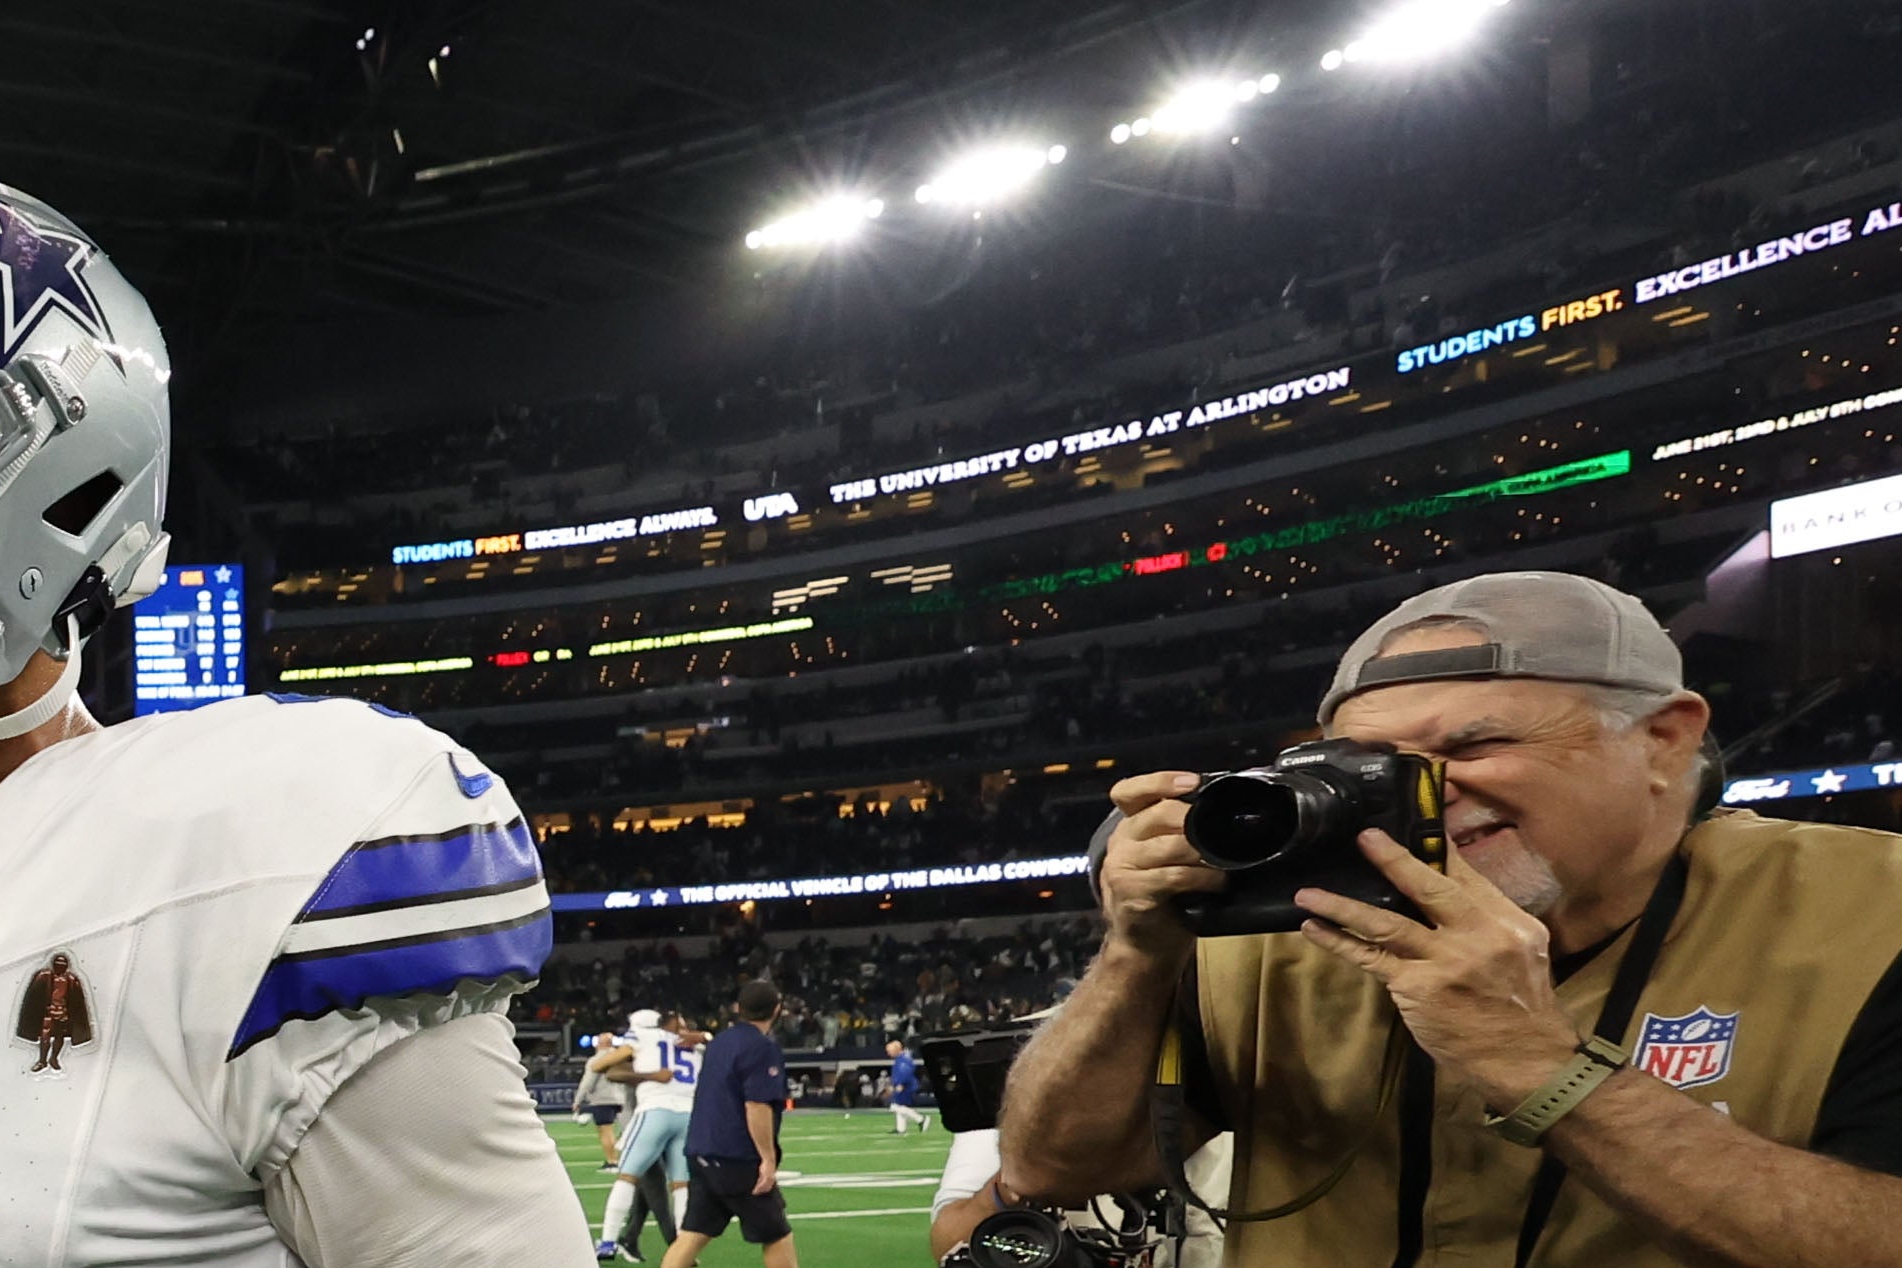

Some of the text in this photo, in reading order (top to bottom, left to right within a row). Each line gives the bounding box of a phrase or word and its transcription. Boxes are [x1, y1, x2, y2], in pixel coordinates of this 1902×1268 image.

[1397, 315, 1536, 373] STUDENTS
[1542, 289, 1623, 331] FIRST.
[1636, 217, 1853, 303] EXCELLENCE
[830, 367, 1351, 503] THE UNIVERSITY OF TEXAS AT ARLINGTON
[743, 492, 798, 521] UTA
[393, 540, 473, 564] STUDENTS
[475, 533, 521, 556] FIRST.
[525, 519, 636, 550] EXCELLENCE
[1281, 754, 1326, 766] Canon
[680, 885, 714, 903] THE
[714, 879, 790, 901] OFFICIAL
[791, 874, 863, 897] VEHICLE
[864, 872, 891, 892] OF
[891, 869, 928, 890] THE
[929, 862, 1002, 887] DALLAS
[657, 1040, 695, 1084] 15
[1645, 1042, 1719, 1084] NFL
